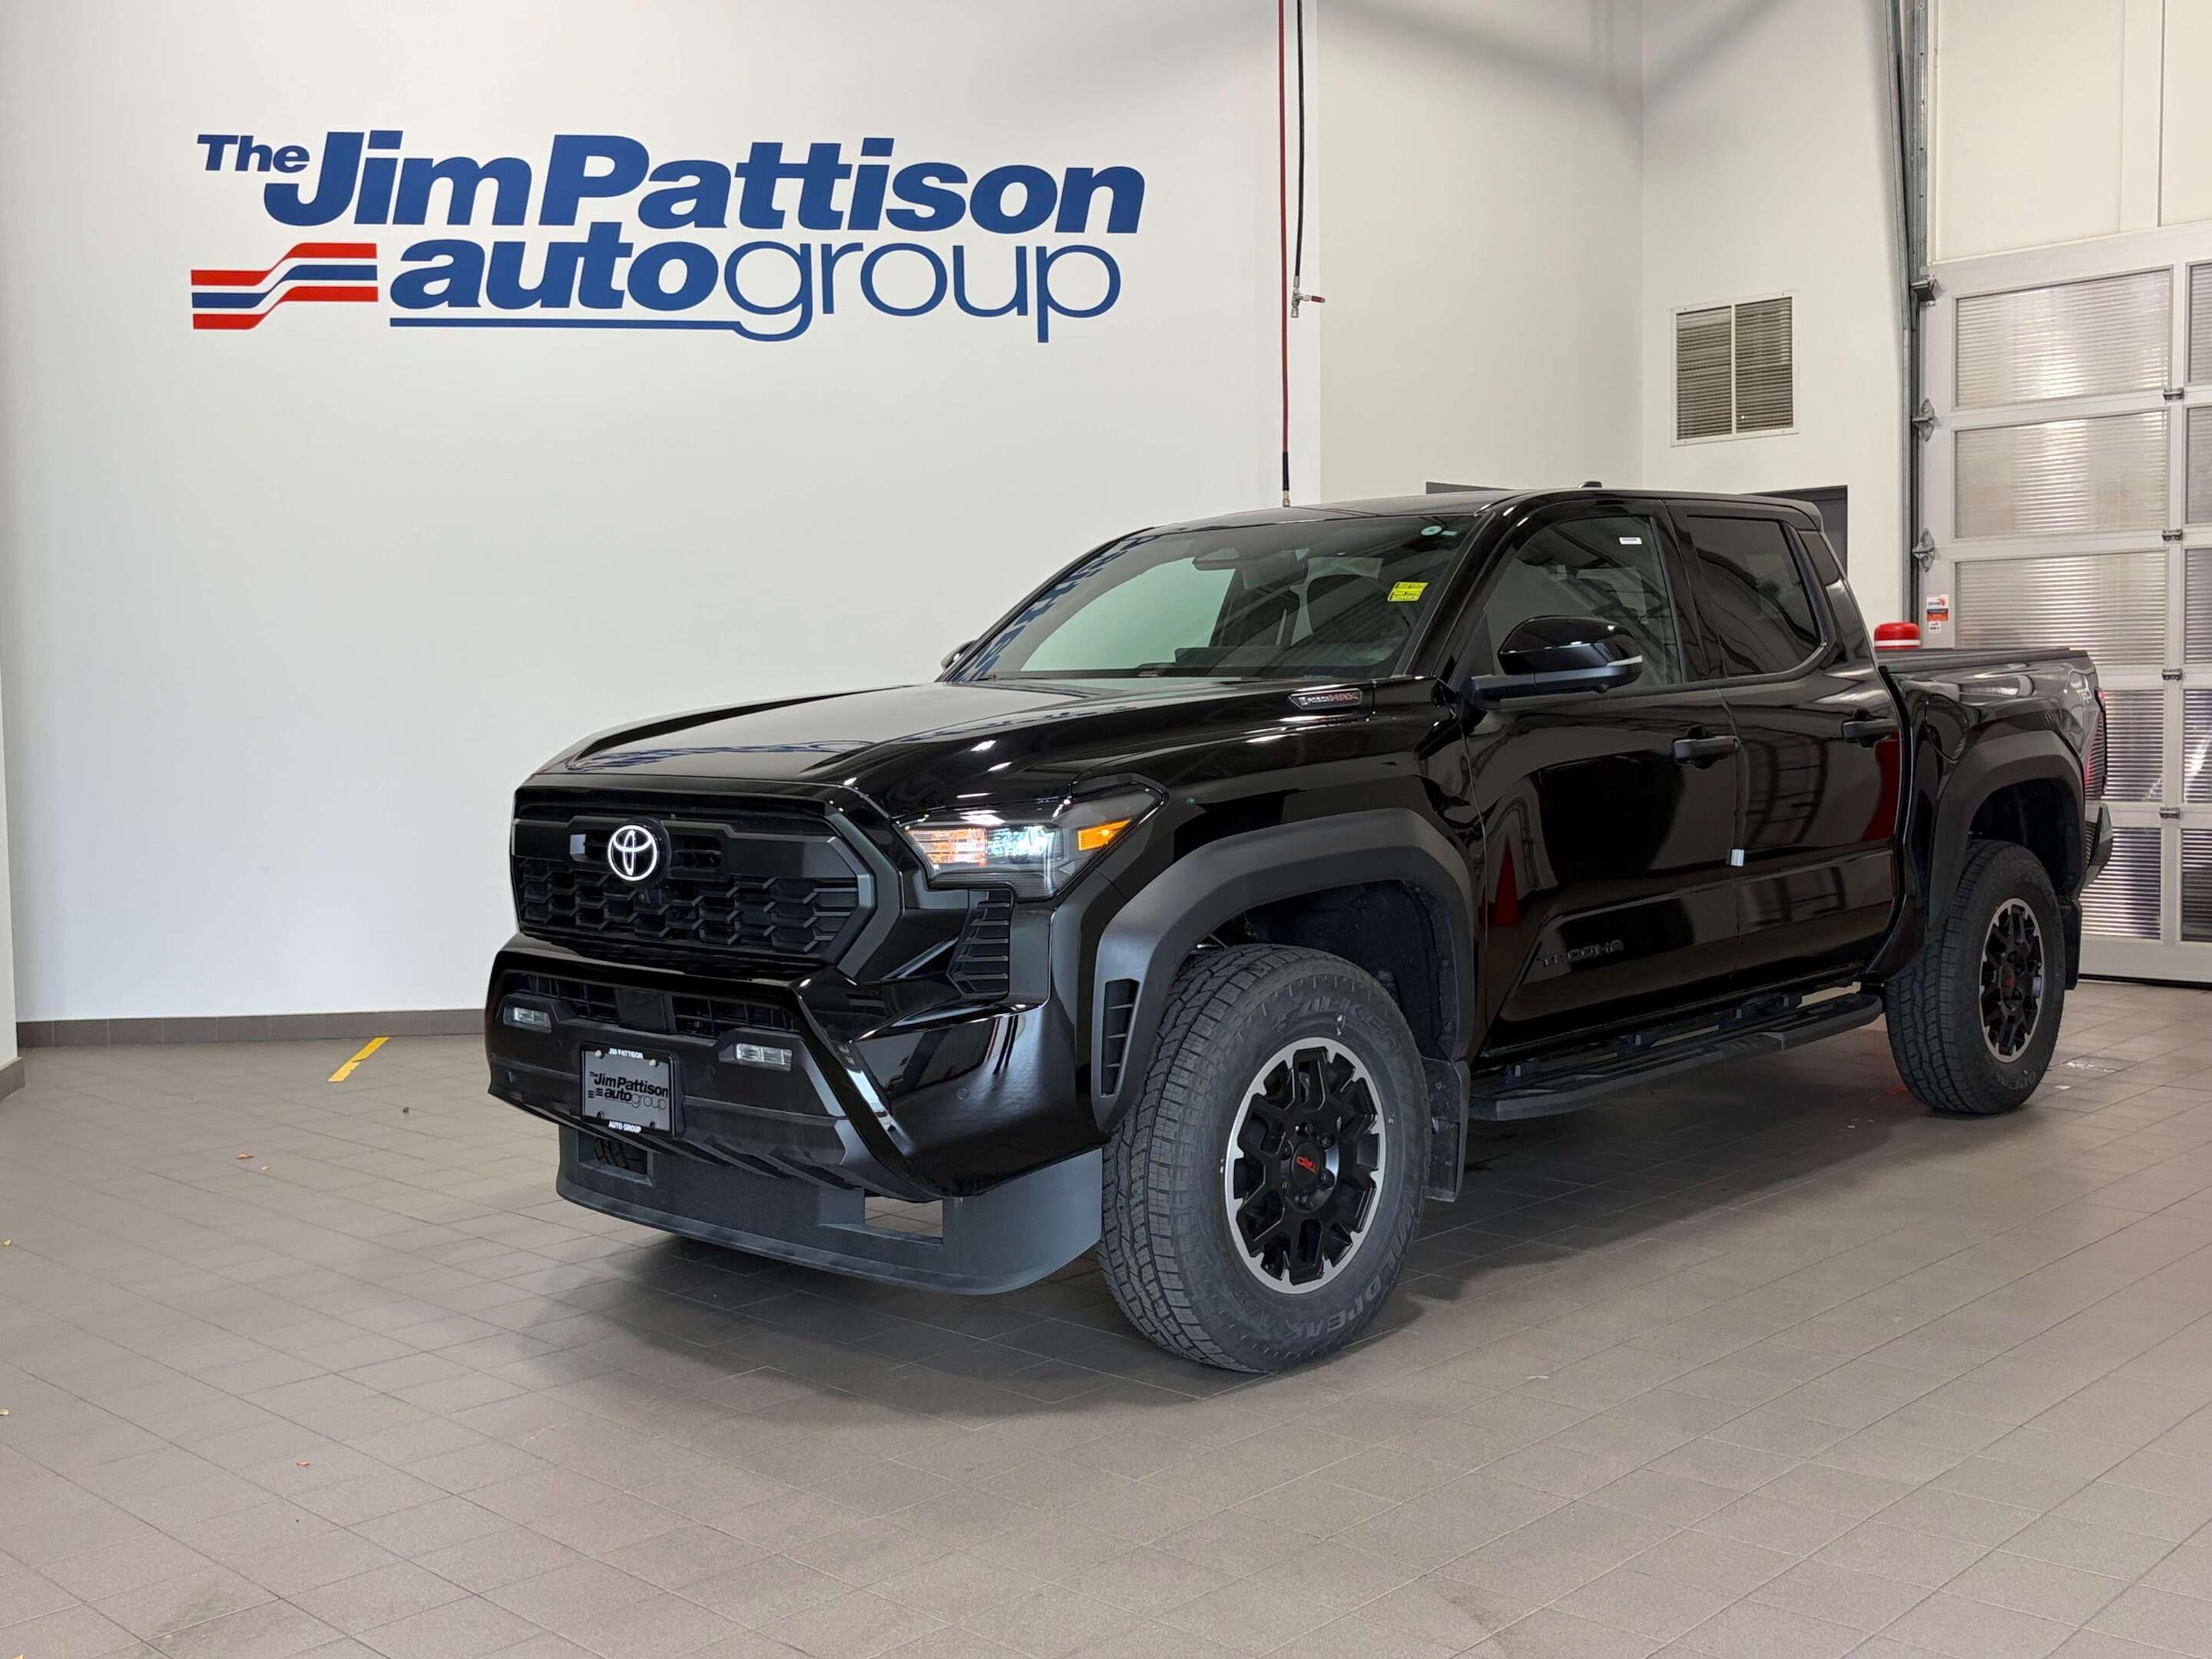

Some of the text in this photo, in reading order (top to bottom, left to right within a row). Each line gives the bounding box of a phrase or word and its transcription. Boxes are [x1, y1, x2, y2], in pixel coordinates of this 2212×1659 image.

[197, 134, 307, 173] The
[618, 1049, 644, 1059] PATTISON
[608, 1121, 642, 1133] AUTO GROUP
